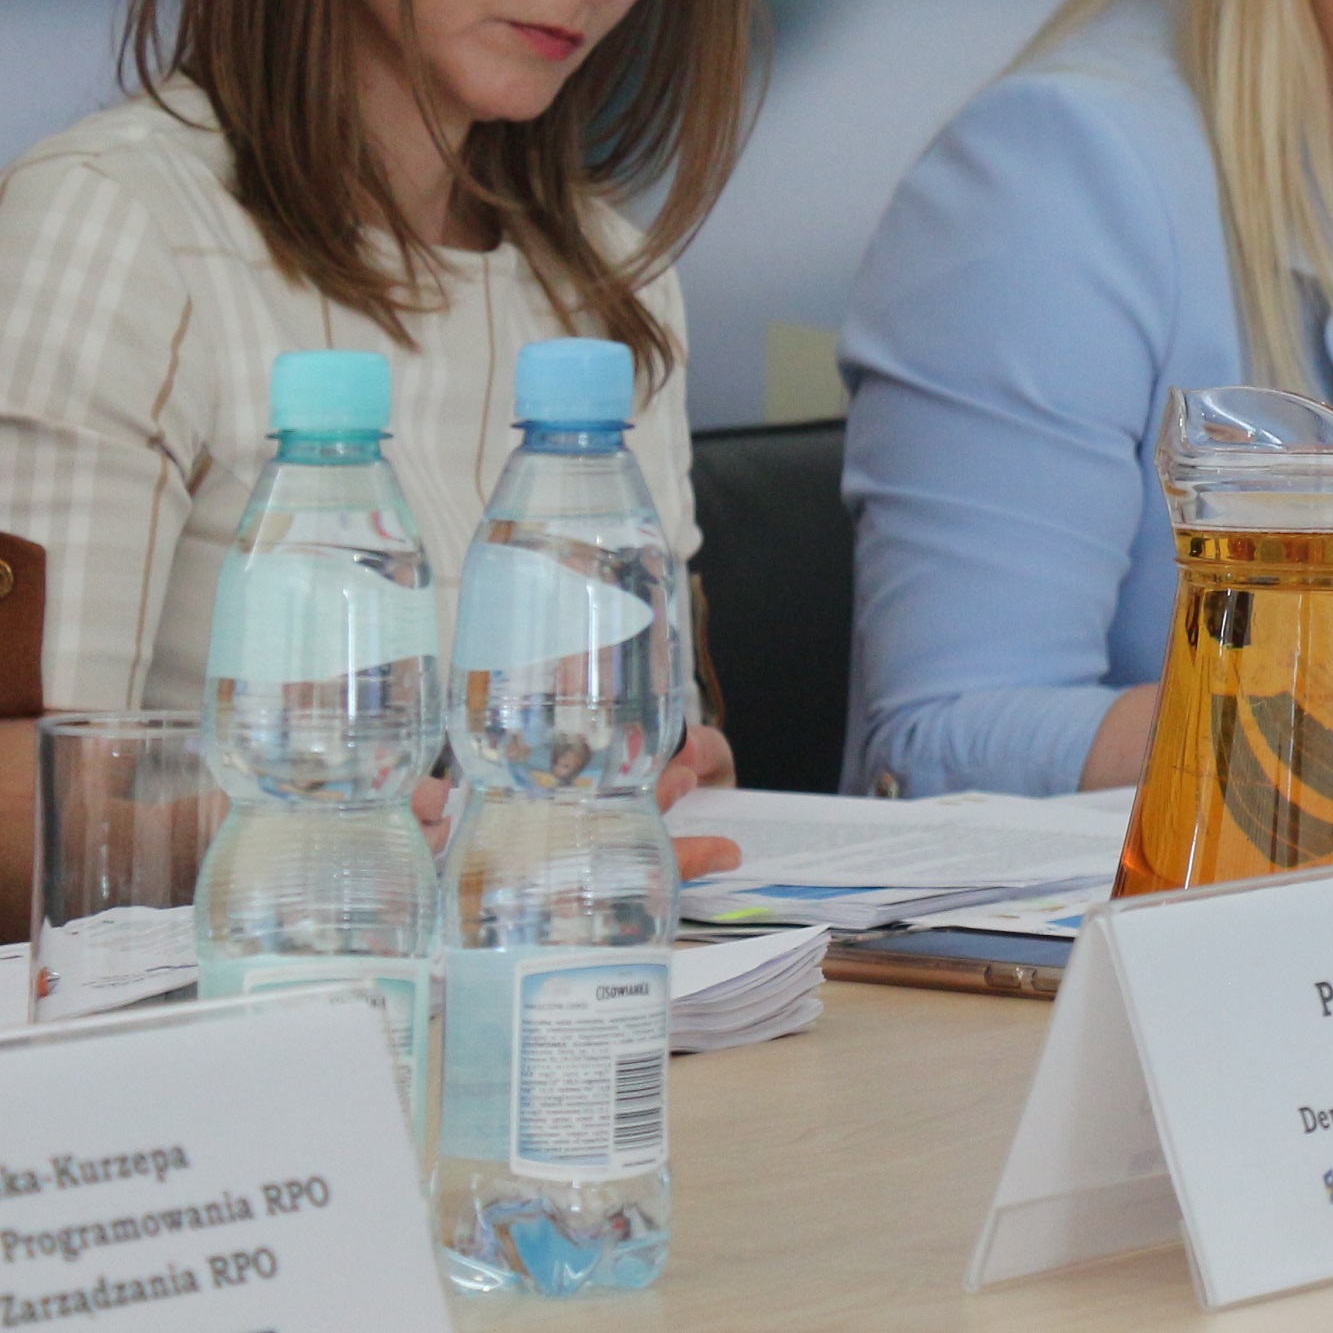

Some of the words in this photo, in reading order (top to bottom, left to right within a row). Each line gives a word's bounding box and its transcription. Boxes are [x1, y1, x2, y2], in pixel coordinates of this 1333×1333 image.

[596, 982, 649, 1001] CISOWIANKA
[0, 1144, 190, 1199] ka-Kurzepa
[1, 1191, 255, 1261] Programowania
[261, 1175, 330, 1216] RPO
[0, 1263, 200, 1328] Zarządzania
[207, 1246, 278, 1289] RPO
